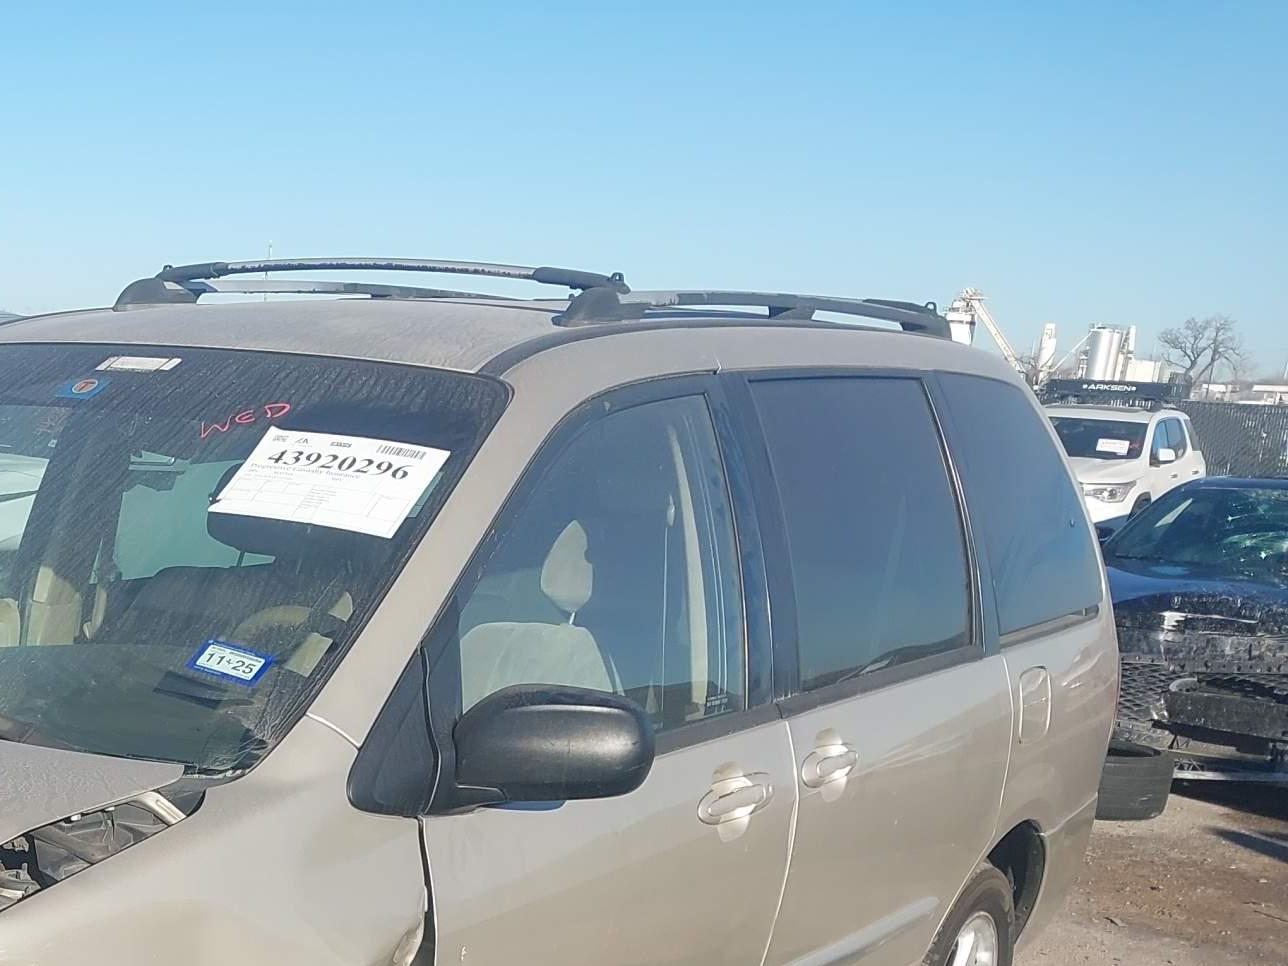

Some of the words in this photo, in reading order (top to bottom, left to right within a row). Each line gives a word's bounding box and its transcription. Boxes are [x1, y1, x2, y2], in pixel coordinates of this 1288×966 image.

[1087, 383, 1132, 392] ARKSEN
[200, 403, 291, 439] WED
[267, 448, 414, 480] 43920296
